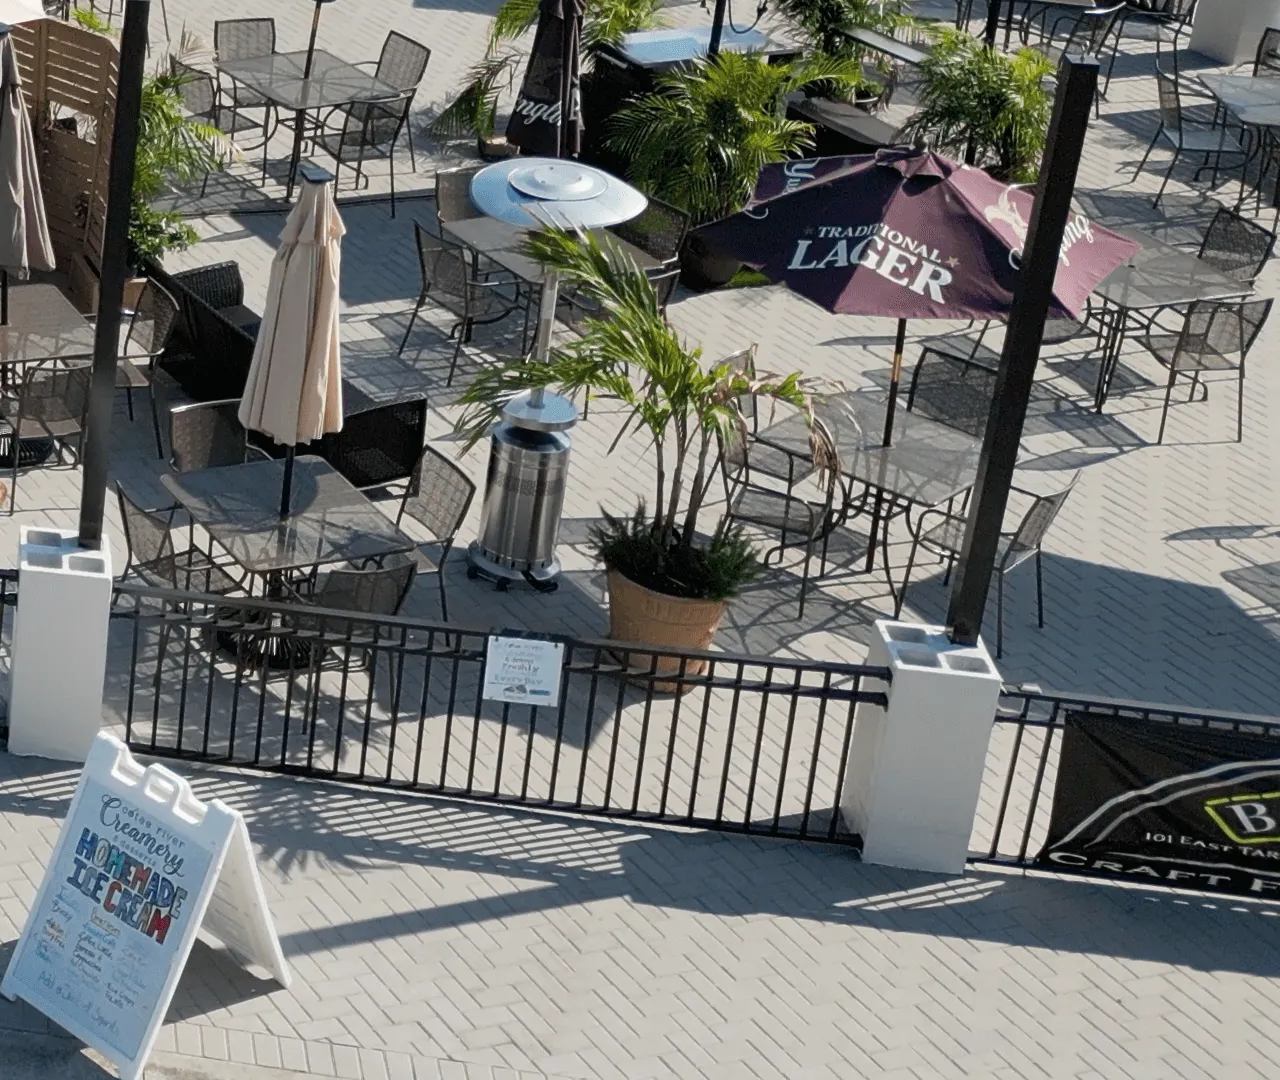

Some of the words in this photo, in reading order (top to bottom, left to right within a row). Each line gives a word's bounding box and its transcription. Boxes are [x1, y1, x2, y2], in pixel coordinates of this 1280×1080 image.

[817, 222, 943, 263] TRADITIONAL
[787, 236, 953, 305] LAGER
[100, 794, 185, 877] Creamery
[156, 827, 186, 849] river
[1145, 832, 1173, 844] 101
[1180, 836, 1234, 852] EAST
[75, 827, 188, 919] HOMEMADE
[1049, 852, 1232, 886] CRAFT
[67, 856, 109, 904] ICE
[103, 880, 172, 945] CREAM
